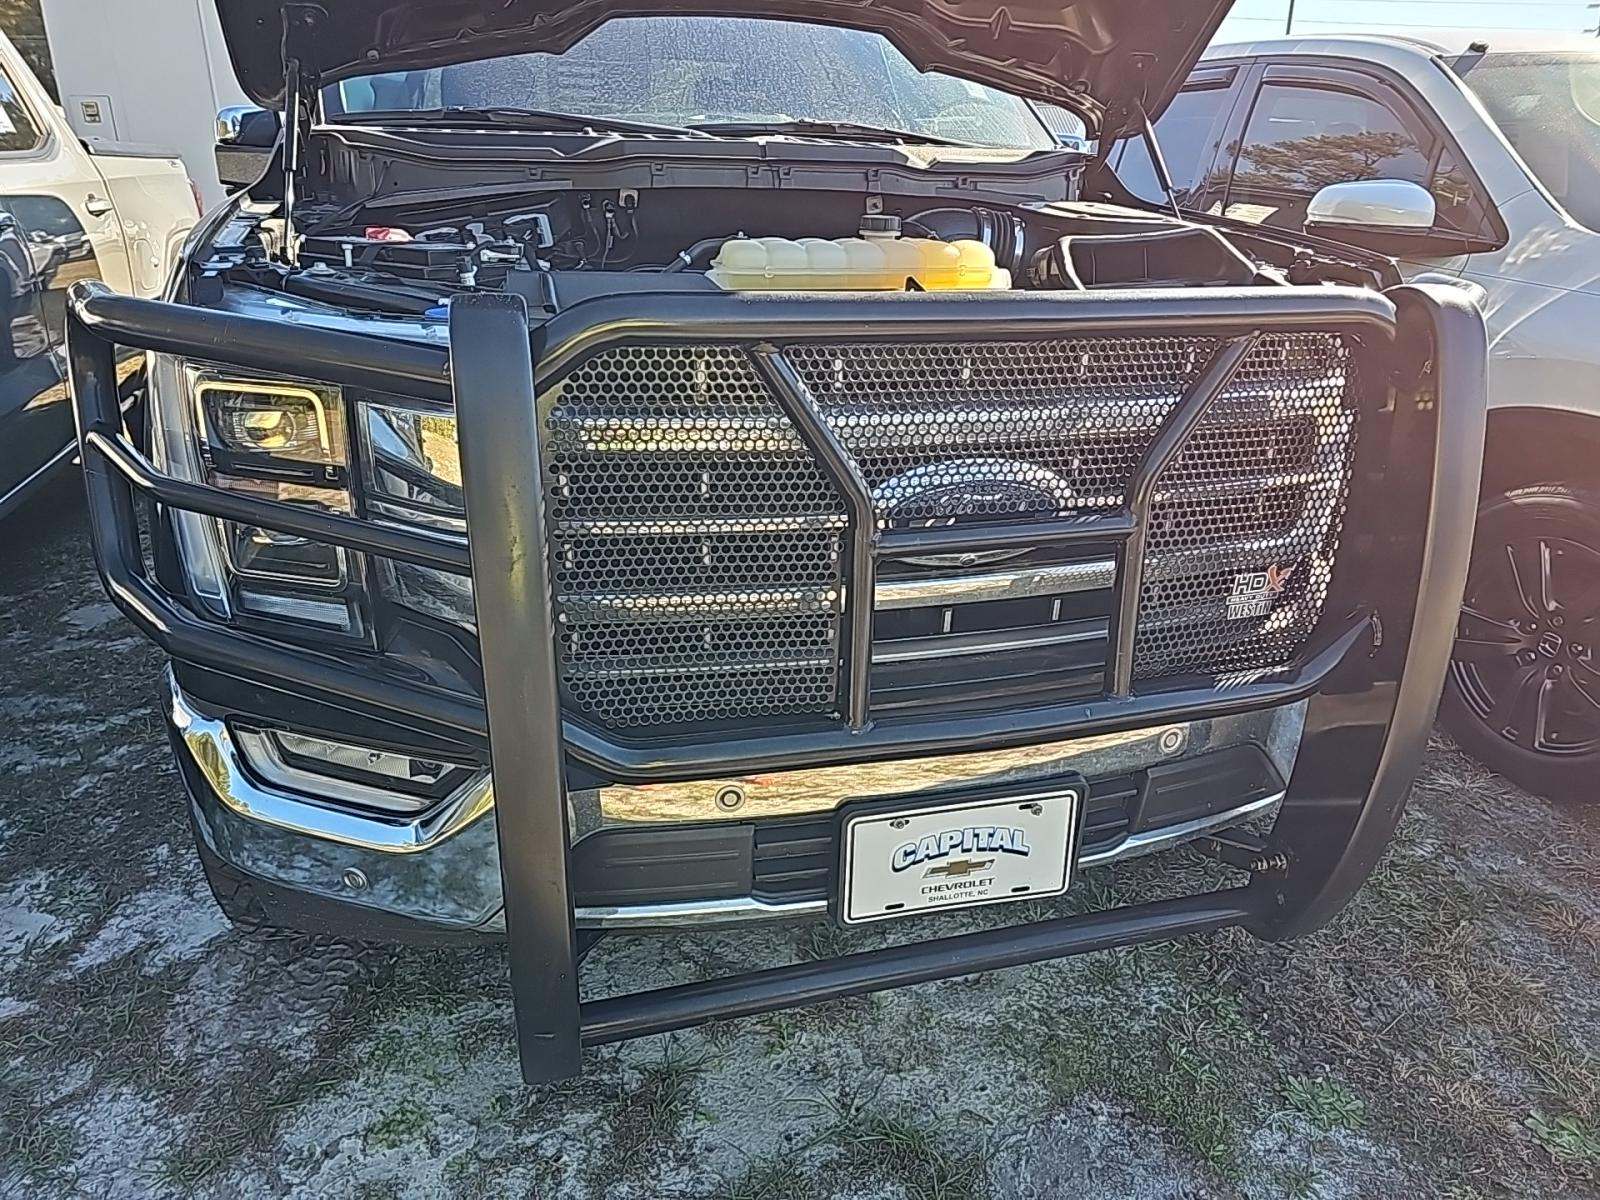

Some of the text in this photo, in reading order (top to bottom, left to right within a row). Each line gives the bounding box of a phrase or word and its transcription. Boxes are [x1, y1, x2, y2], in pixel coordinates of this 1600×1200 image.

[1232, 563, 1292, 595] HDX
[1230, 595, 1253, 603] HEAVY
[892, 826, 1030, 872] CAPITAL
[921, 878, 995, 894] CHEVROLET
[928, 891, 975, 903] SHALLOTTE,
